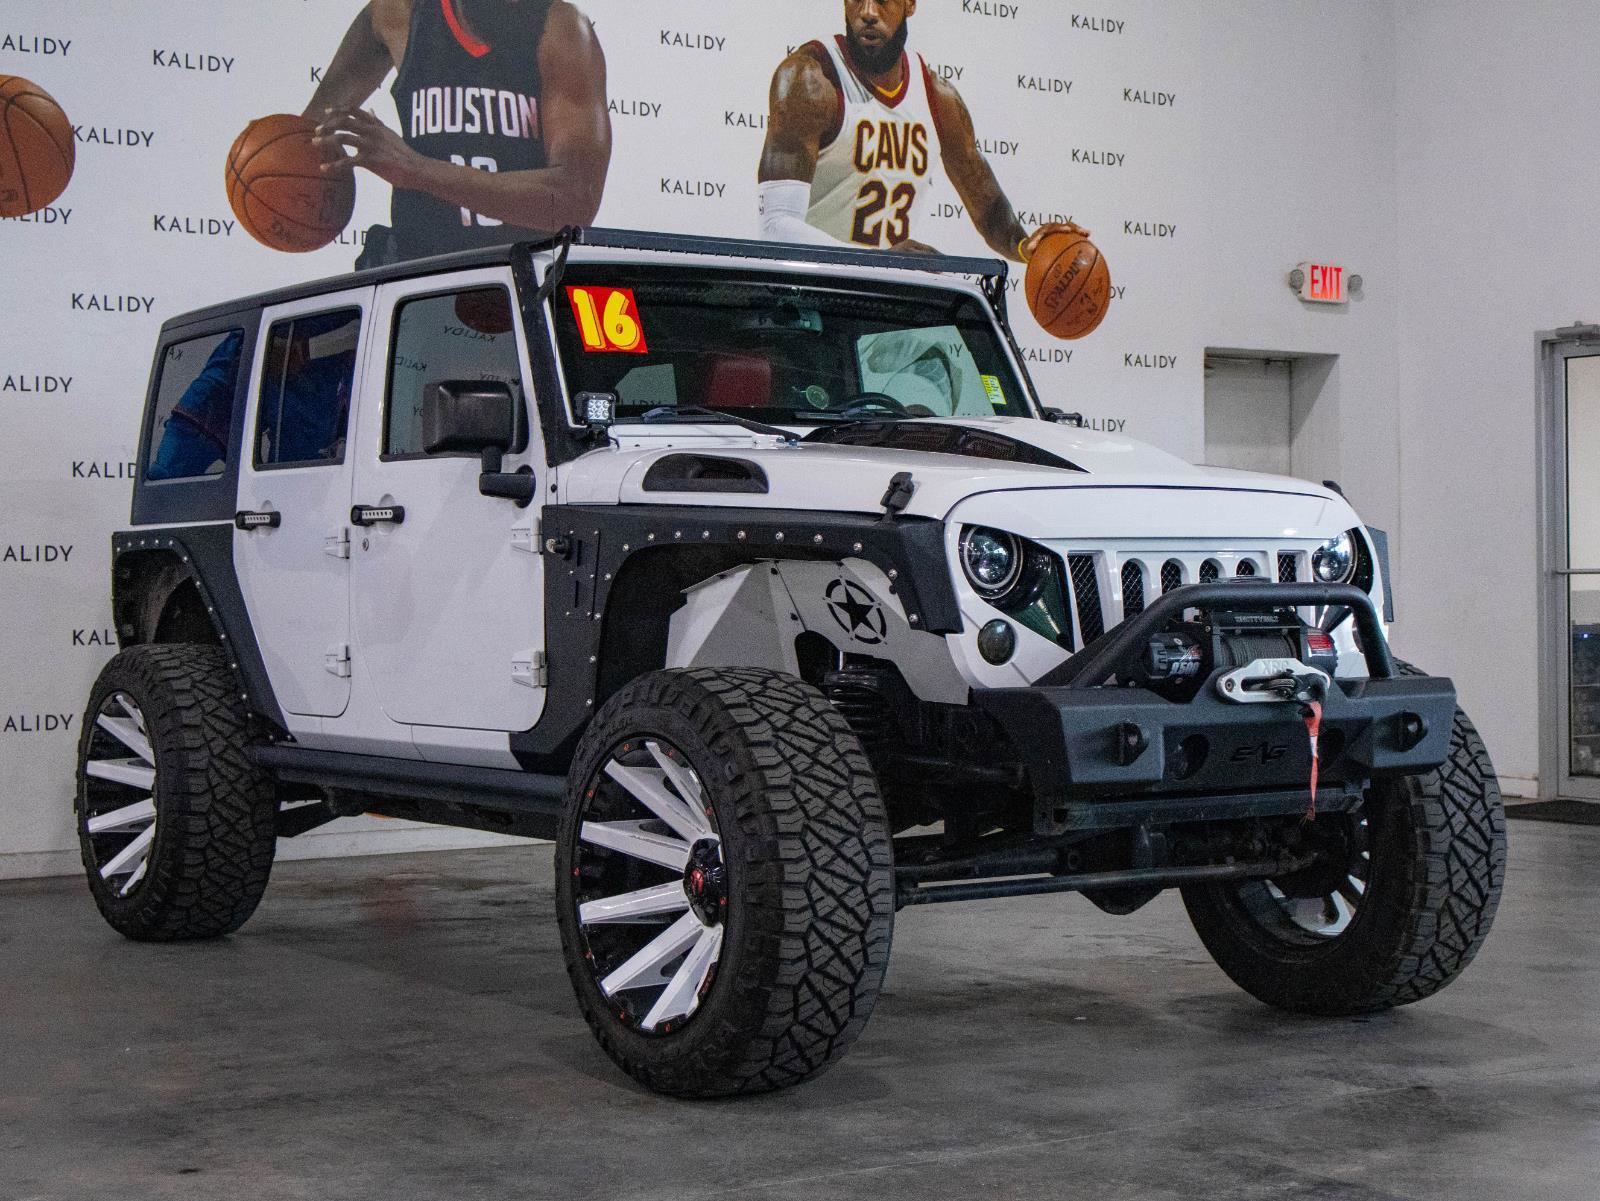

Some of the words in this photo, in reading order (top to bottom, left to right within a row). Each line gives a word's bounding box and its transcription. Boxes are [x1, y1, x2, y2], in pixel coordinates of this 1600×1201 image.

[963, 0, 1019, 20] KALIDY
[1071, 14, 1125, 34] KALIDY
[1, 34, 72, 57] ALIDY
[660, 30, 726, 52] KALIDY
[153, 50, 235, 74] KALIDY
[1017, 75, 1073, 94] KALIDY
[1124, 88, 1176, 107] KALIDY
[411, 87, 540, 139] HOUSTON
[608, 99, 662, 118] ALIDY
[725, 111, 769, 129] KALI
[73, 125, 154, 148] KALIDY
[853, 119, 929, 176] CAVS
[975, 138, 1019, 156] ALIDY
[1071, 149, 1125, 167] KALIDY
[660, 178, 726, 198] KALIDY
[850, 179, 917, 247] 23
[153, 215, 235, 236] KALIDY
[1124, 220, 1177, 238] KALIDY
[1310, 264, 1342, 300] EXIT
[72, 293, 155, 314] KALIDY
[573, 288, 640, 350] 16
[1124, 353, 1177, 369] KALIDY
[2, 375, 73, 394] ALIDY
[1082, 418, 1126, 432] ALIDY
[72, 461, 136, 479] KALI
[2, 545, 73, 562] ALIDY
[72, 629, 116, 646] KAL
[3, 714, 74, 733] ALIDY
